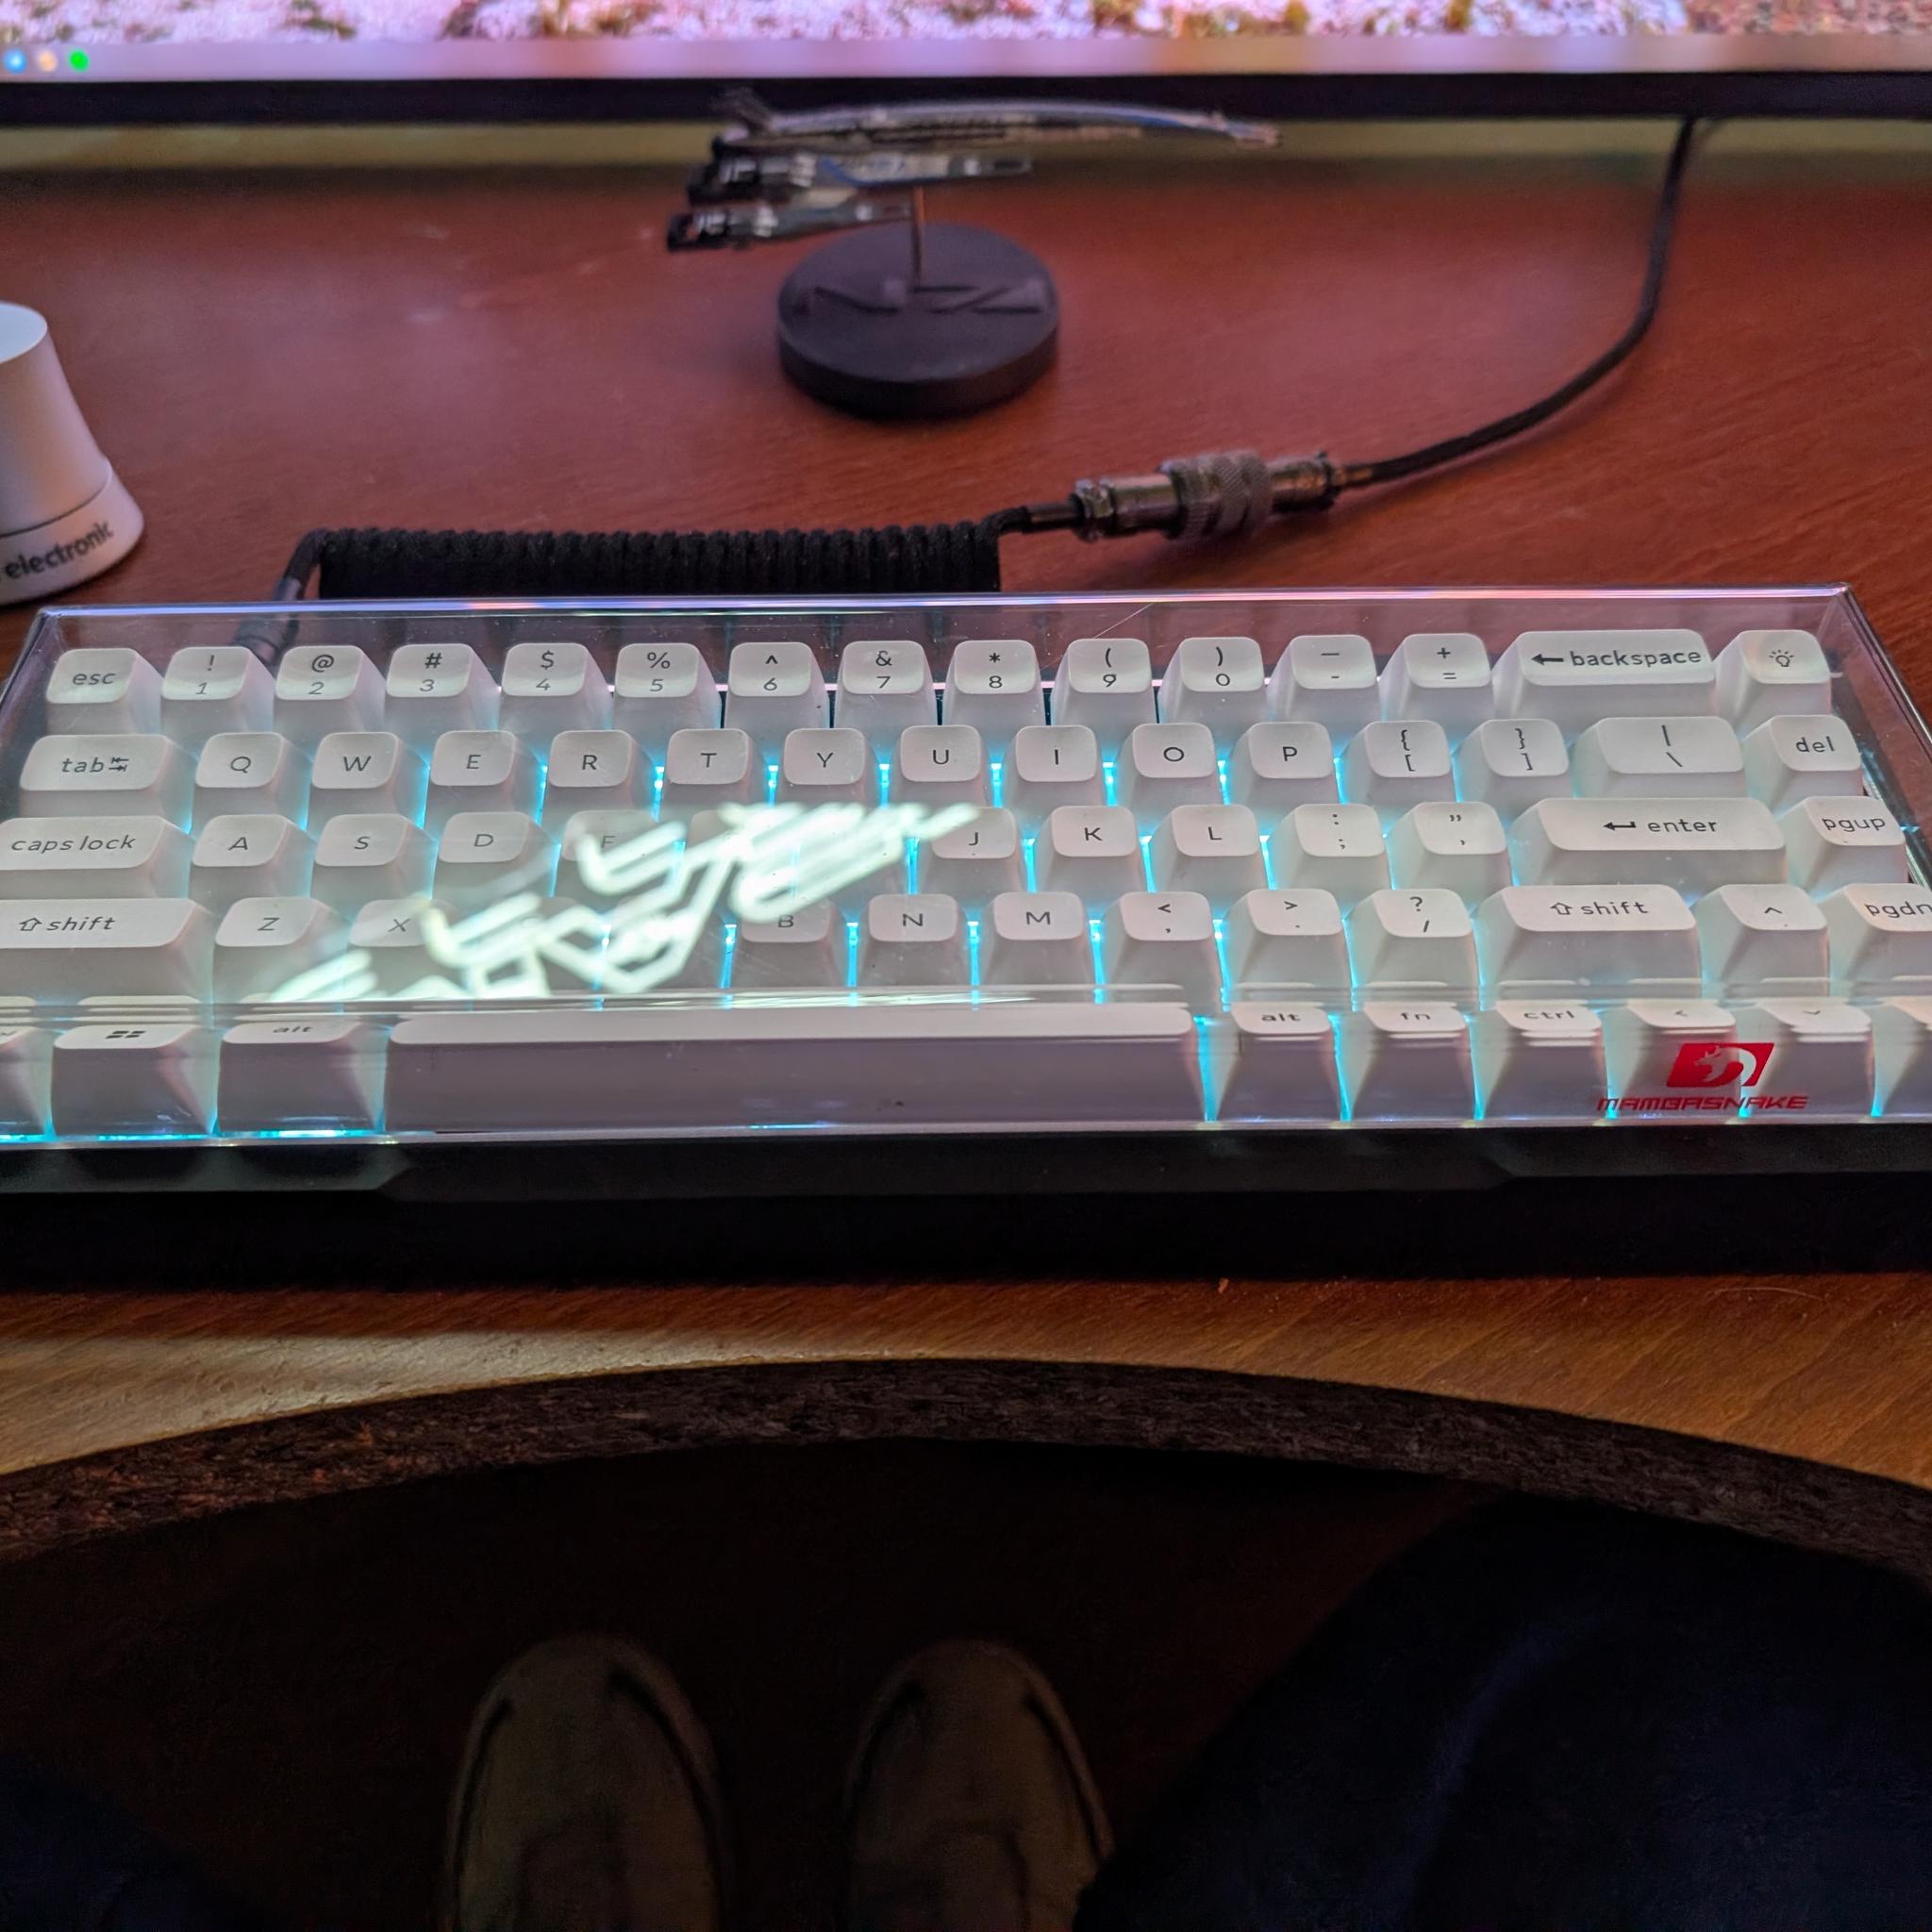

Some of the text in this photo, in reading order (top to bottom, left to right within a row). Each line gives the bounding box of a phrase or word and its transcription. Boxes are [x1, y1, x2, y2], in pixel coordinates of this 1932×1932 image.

[540, 649, 555, 671] $
[646, 651, 672, 670] %
[874, 649, 892, 667] &
[1104, 647, 1112, 669] (
[1215, 645, 1224, 667] )
[1436, 646, 1452, 659] +
[1569, 649, 1702, 669] backspace
[207, 654, 216, 672] !
[310, 653, 335, 674] @
[424, 652, 443, 670] #
[72, 672, 117, 686] esc
[535, 677, 551, 691] 4
[649, 677, 664, 692] 5
[762, 676, 778, 691] 6
[876, 675, 891, 690] 7
[988, 675, 1004, 690] 8
[1102, 673, 1118, 689] 9
[1441, 672, 1457, 681] =
[194, 681, 208, 695] 1
[307, 680, 325, 696] 2
[419, 678, 435, 692] 3
[1400, 728, 1410, 752] {
[1514, 727, 1526, 750] }
[1795, 735, 1836, 754] del
[700, 752, 718, 769] T
[816, 752, 834, 769] Y
[932, 749, 950, 766] U
[1162, 746, 1185, 763] O
[1282, 745, 1298, 762] P
[1665, 751, 1684, 768] \
[61, 756, 106, 774] tab
[229, 755, 252, 774] Q
[342, 755, 373, 773] W
[465, 753, 482, 771] E
[581, 754, 598, 771] R
[1404, 753, 1416, 773] [
[1521, 752, 1534, 772] ]
[1331, 813, 1340, 826] :
[1647, 818, 1717, 833] enter
[1821, 817, 1887, 833] pgup
[473, 833, 494, 848] D
[968, 831, 979, 847] J
[1083, 826, 1103, 841] K
[1208, 825, 1223, 841] L
[10, 834, 136, 855] caps lock
[227, 836, 249, 851] A
[353, 835, 371, 851] S
[1338, 838, 1346, 850] ;
[1158, 903, 1172, 914] <
[1283, 900, 1298, 911] >
[1409, 895, 1424, 912] ?
[1580, 900, 1649, 916] shift
[1864, 900, 1932, 919] pgdn
[45, 915, 116, 932] shift
[257, 916, 280, 932] Z
[388, 918, 411, 933] X
[776, 914, 795, 929] B
[902, 912, 924, 927] N
[1024, 910, 1052, 925] M
[1423, 919, 1430, 933] /
[1261, 1012, 1300, 1023] alt
[1523, 1009, 1575, 1020] ctrl
[272, 1024, 314, 1034] alt
